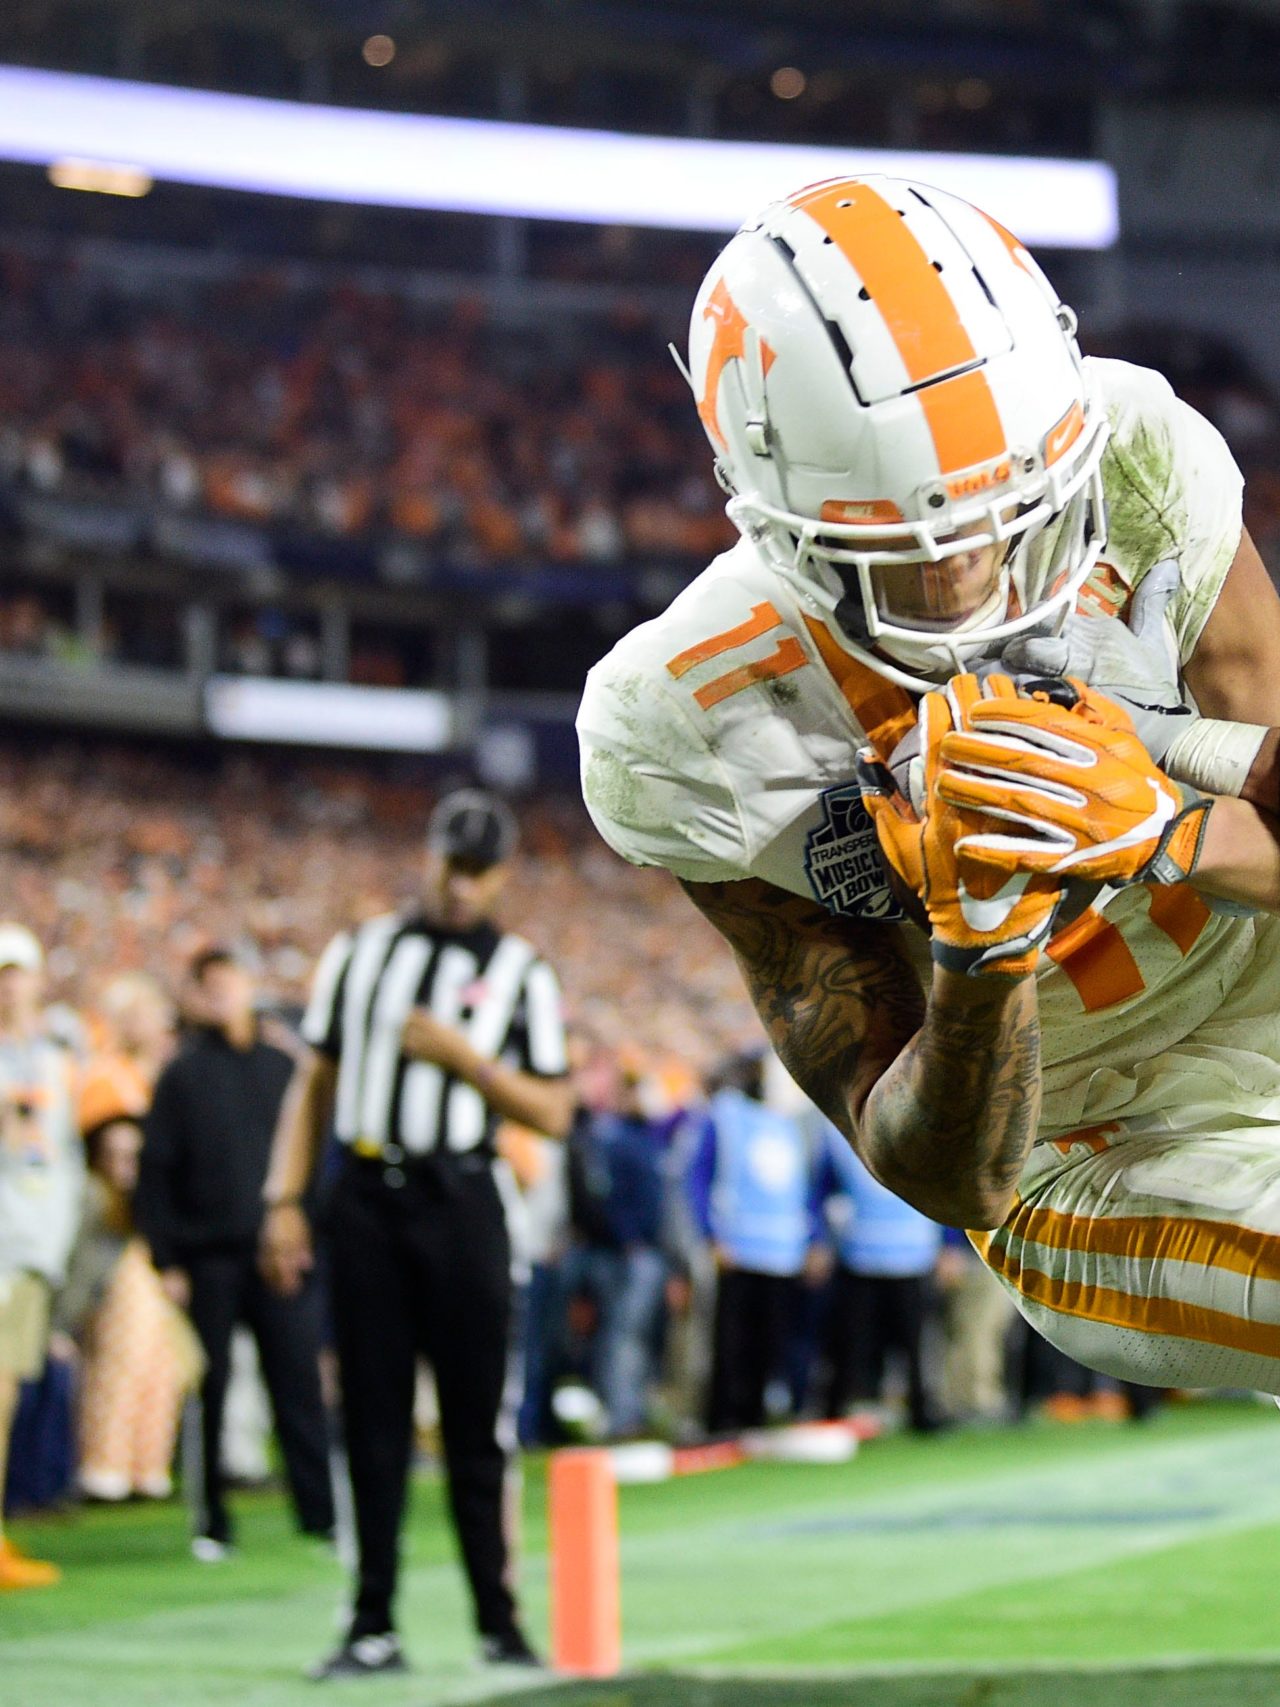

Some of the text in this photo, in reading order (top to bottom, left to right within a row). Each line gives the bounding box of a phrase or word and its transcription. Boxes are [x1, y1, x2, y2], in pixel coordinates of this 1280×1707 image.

[665, 600, 809, 710] 11
[812, 835, 874, 863] TRANSPER
[814, 852, 871, 893] MUSIC
[844, 870, 886, 901] BOW
